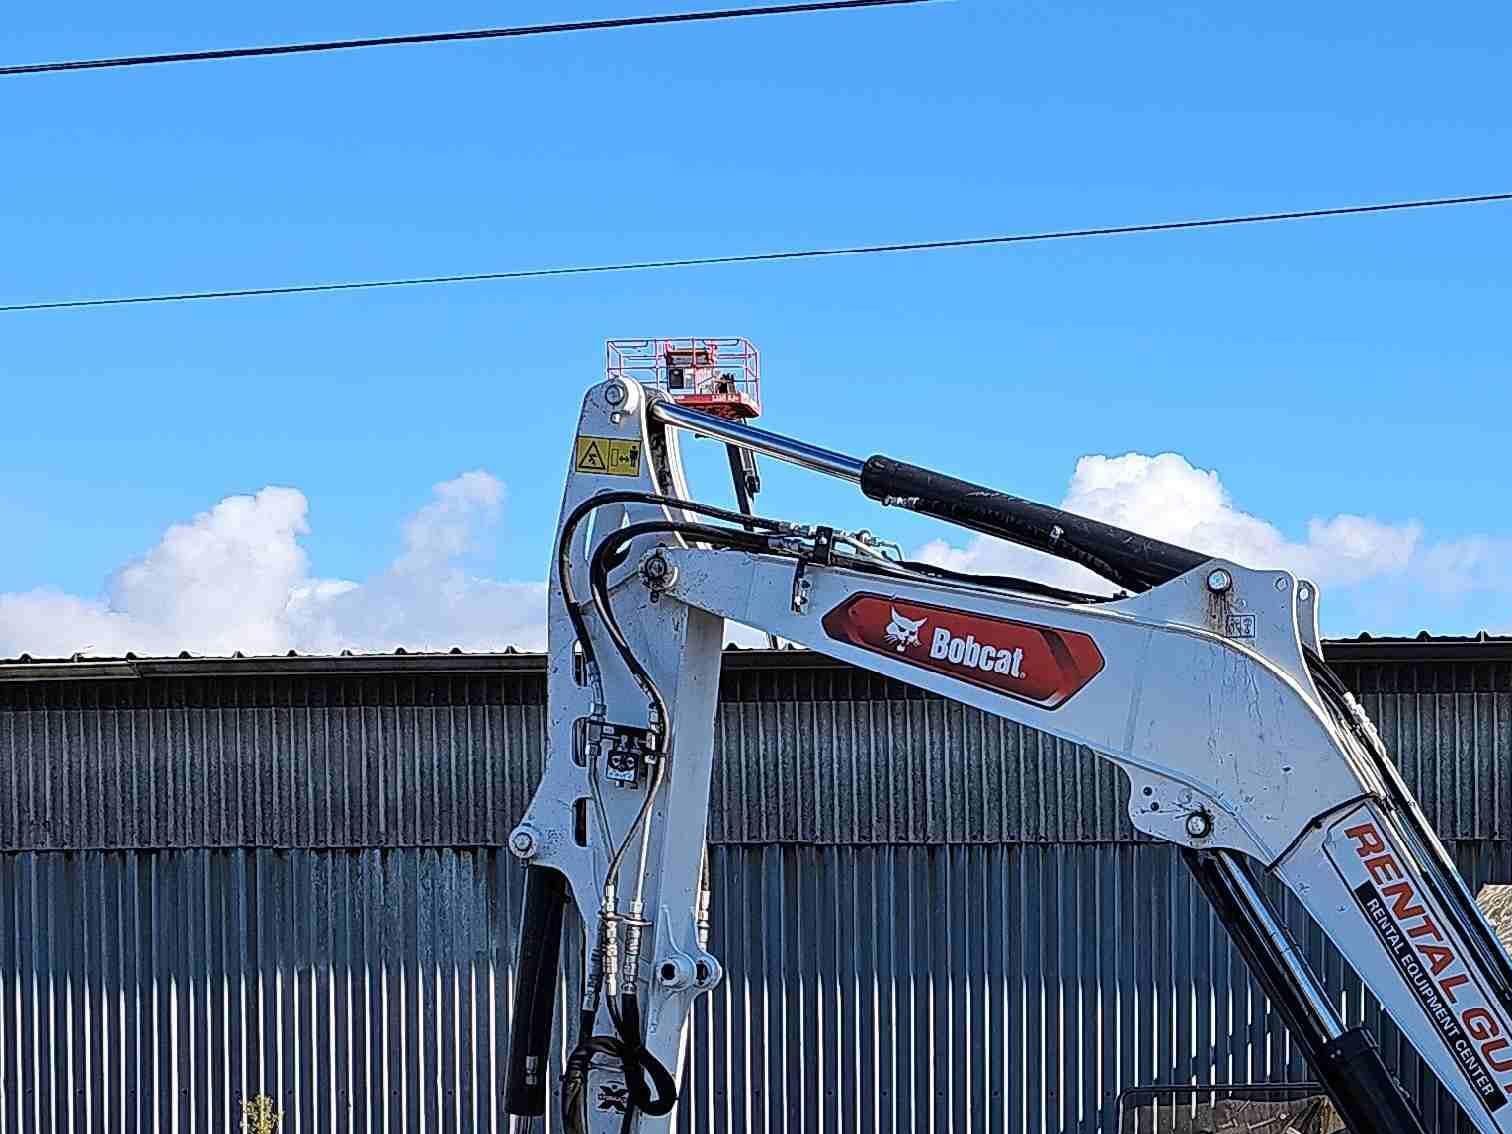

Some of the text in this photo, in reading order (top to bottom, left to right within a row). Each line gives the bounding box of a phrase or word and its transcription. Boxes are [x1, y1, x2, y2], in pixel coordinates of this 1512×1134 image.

[929, 626, 1025, 679] Bobcat
[1344, 823, 1470, 1003] RENTAL
[1365, 897, 1496, 1096] RENTAL EQUIPMENT CENTER
